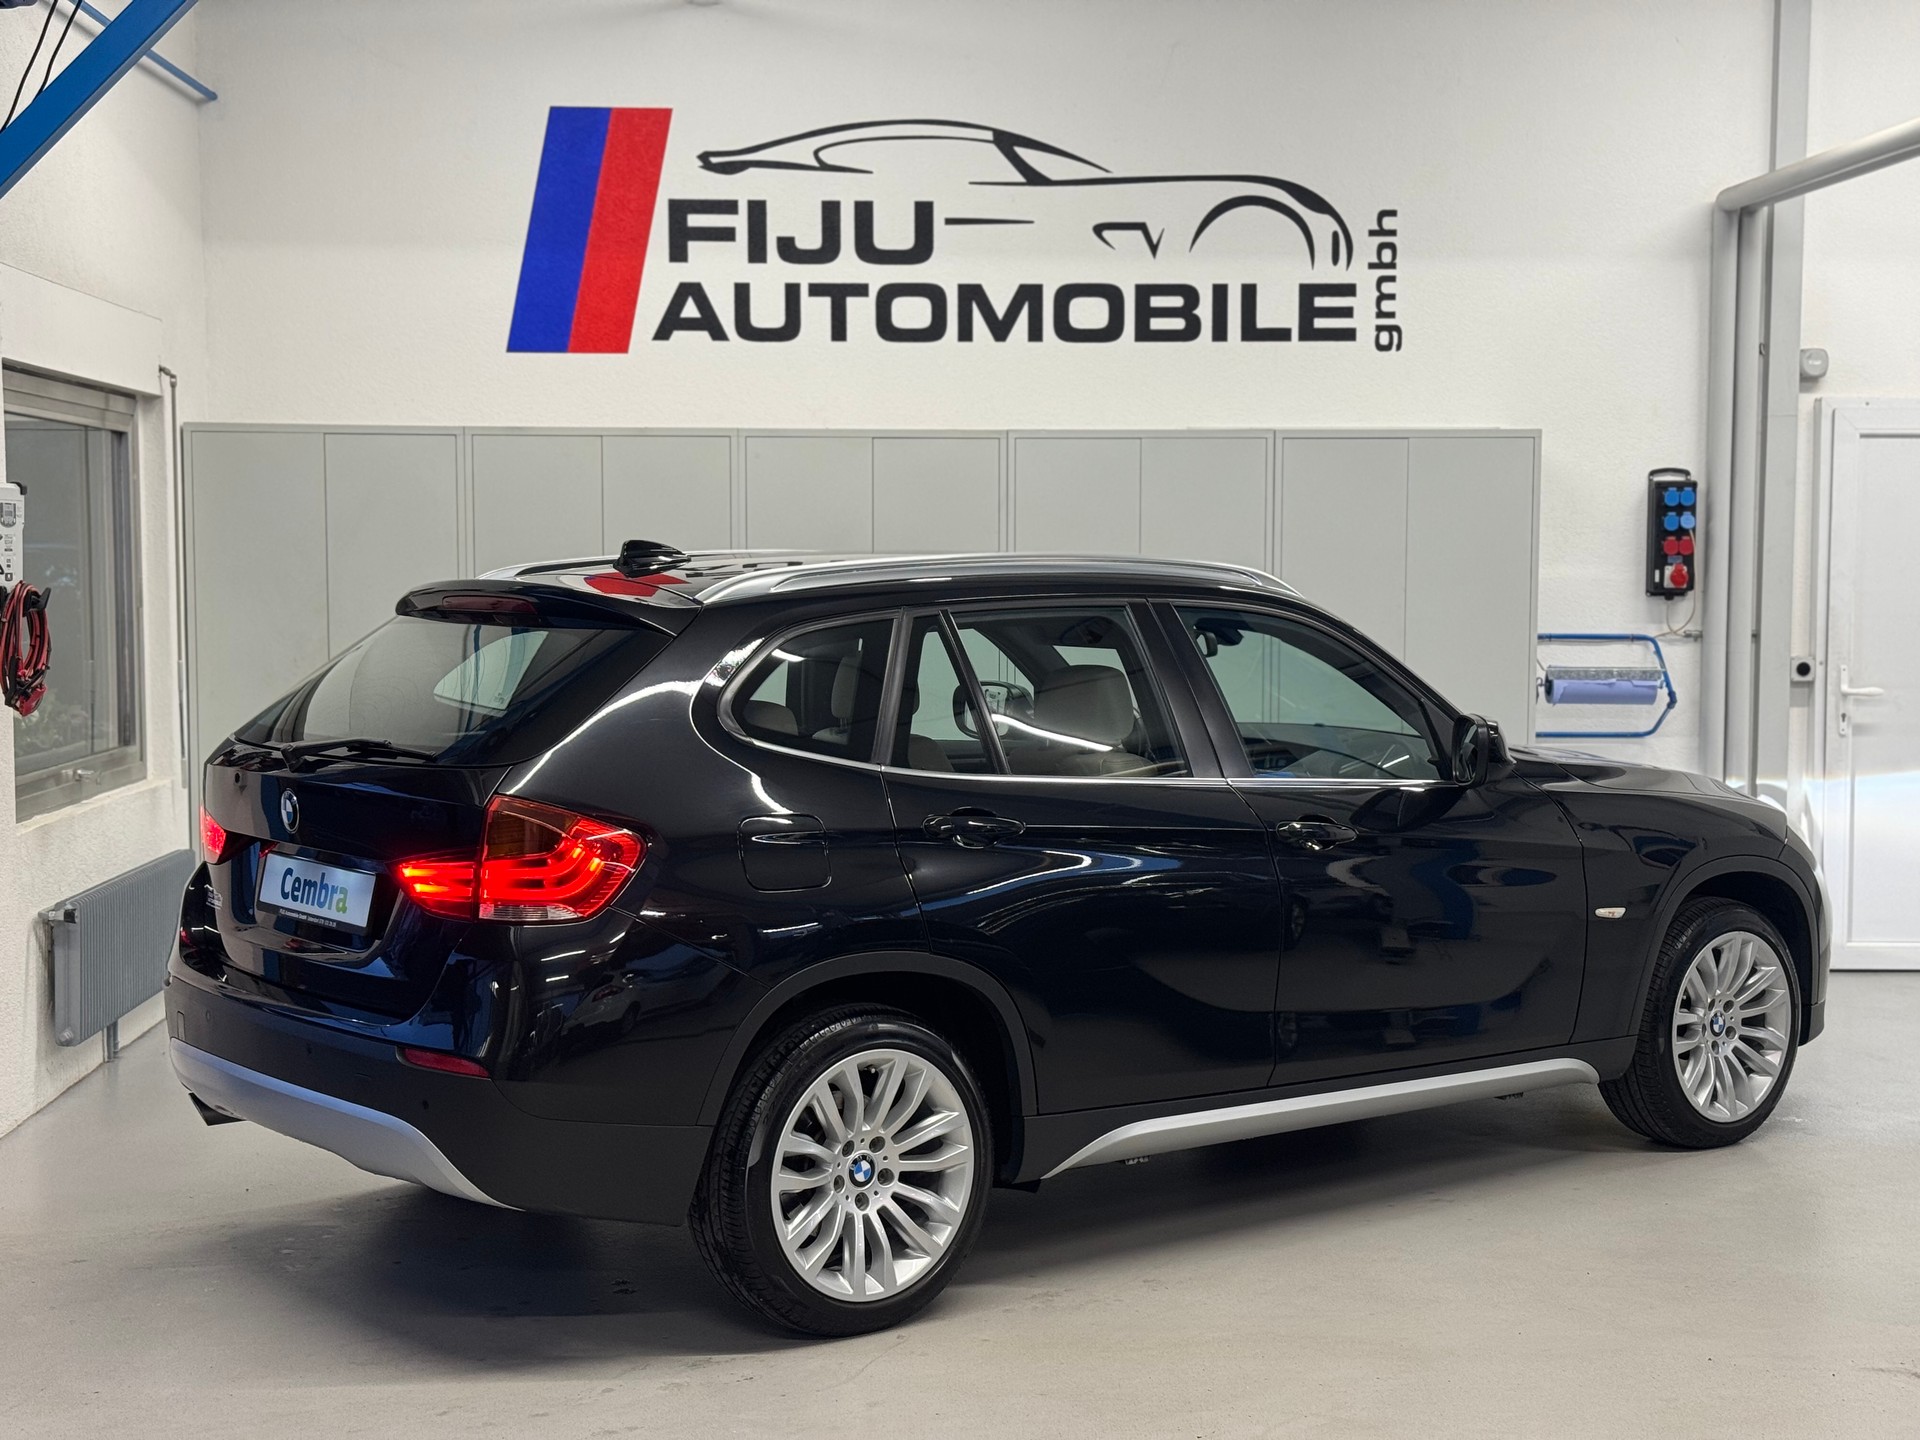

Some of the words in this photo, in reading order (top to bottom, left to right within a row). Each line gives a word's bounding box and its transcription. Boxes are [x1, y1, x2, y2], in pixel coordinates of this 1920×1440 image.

[668, 198, 934, 266] FIJU
[652, 281, 1358, 343] AUTOMOBILE
[1367, 209, 1403, 352] gmbh
[280, 867, 348, 914] Cembra
